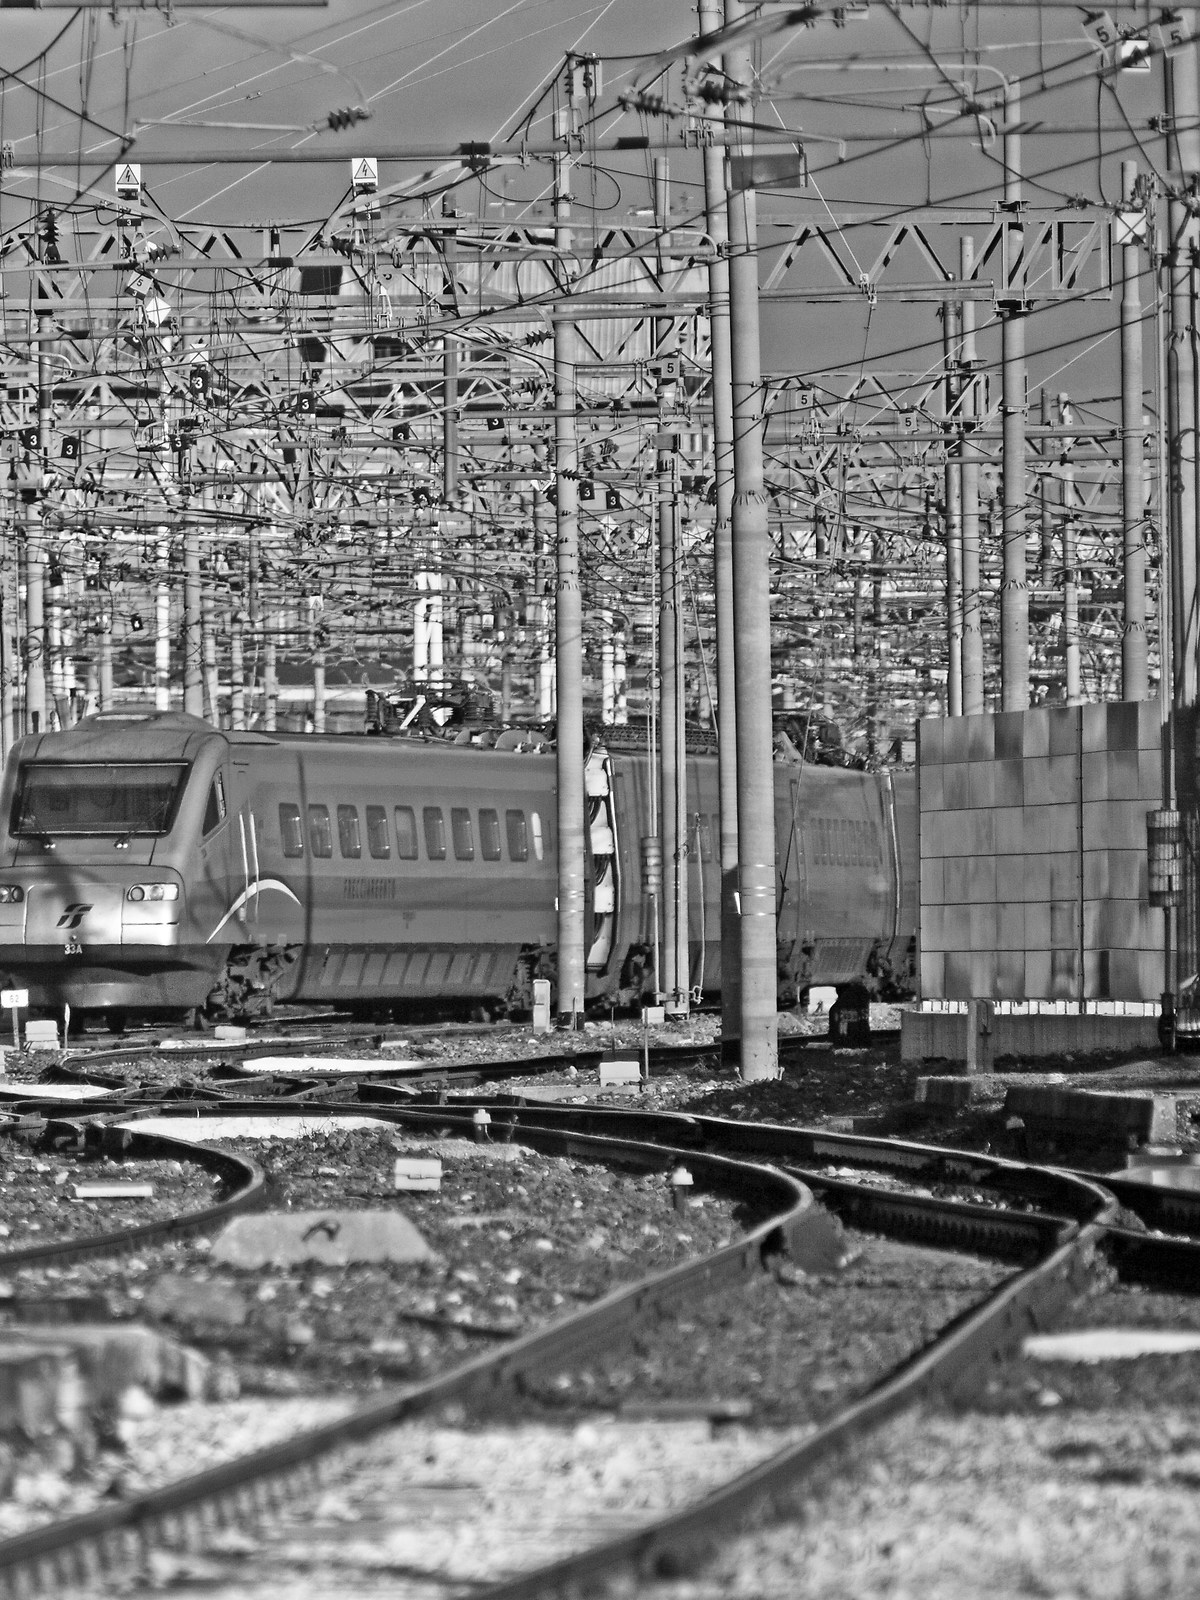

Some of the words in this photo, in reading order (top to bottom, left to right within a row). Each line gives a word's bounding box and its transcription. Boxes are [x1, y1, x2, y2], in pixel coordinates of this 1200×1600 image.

[1096, 26, 1110, 43] 5
[1170, 30, 1183, 46] 5
[136, 278, 144, 287] 5
[667, 363, 675, 373] 5
[302, 399, 309, 410] 3
[801, 394, 808, 405] 5
[905, 417, 912, 427] 5
[30, 434, 38, 446] 3
[175, 437, 182, 447] 3
[6, 444, 13, 453] 4
[66, 444, 73, 455] 3
[505, 482, 511, 490] 4
[585, 487, 591, 497] 3
[610, 496, 616, 505] 3
[64, 944, 83, 955] 33A
